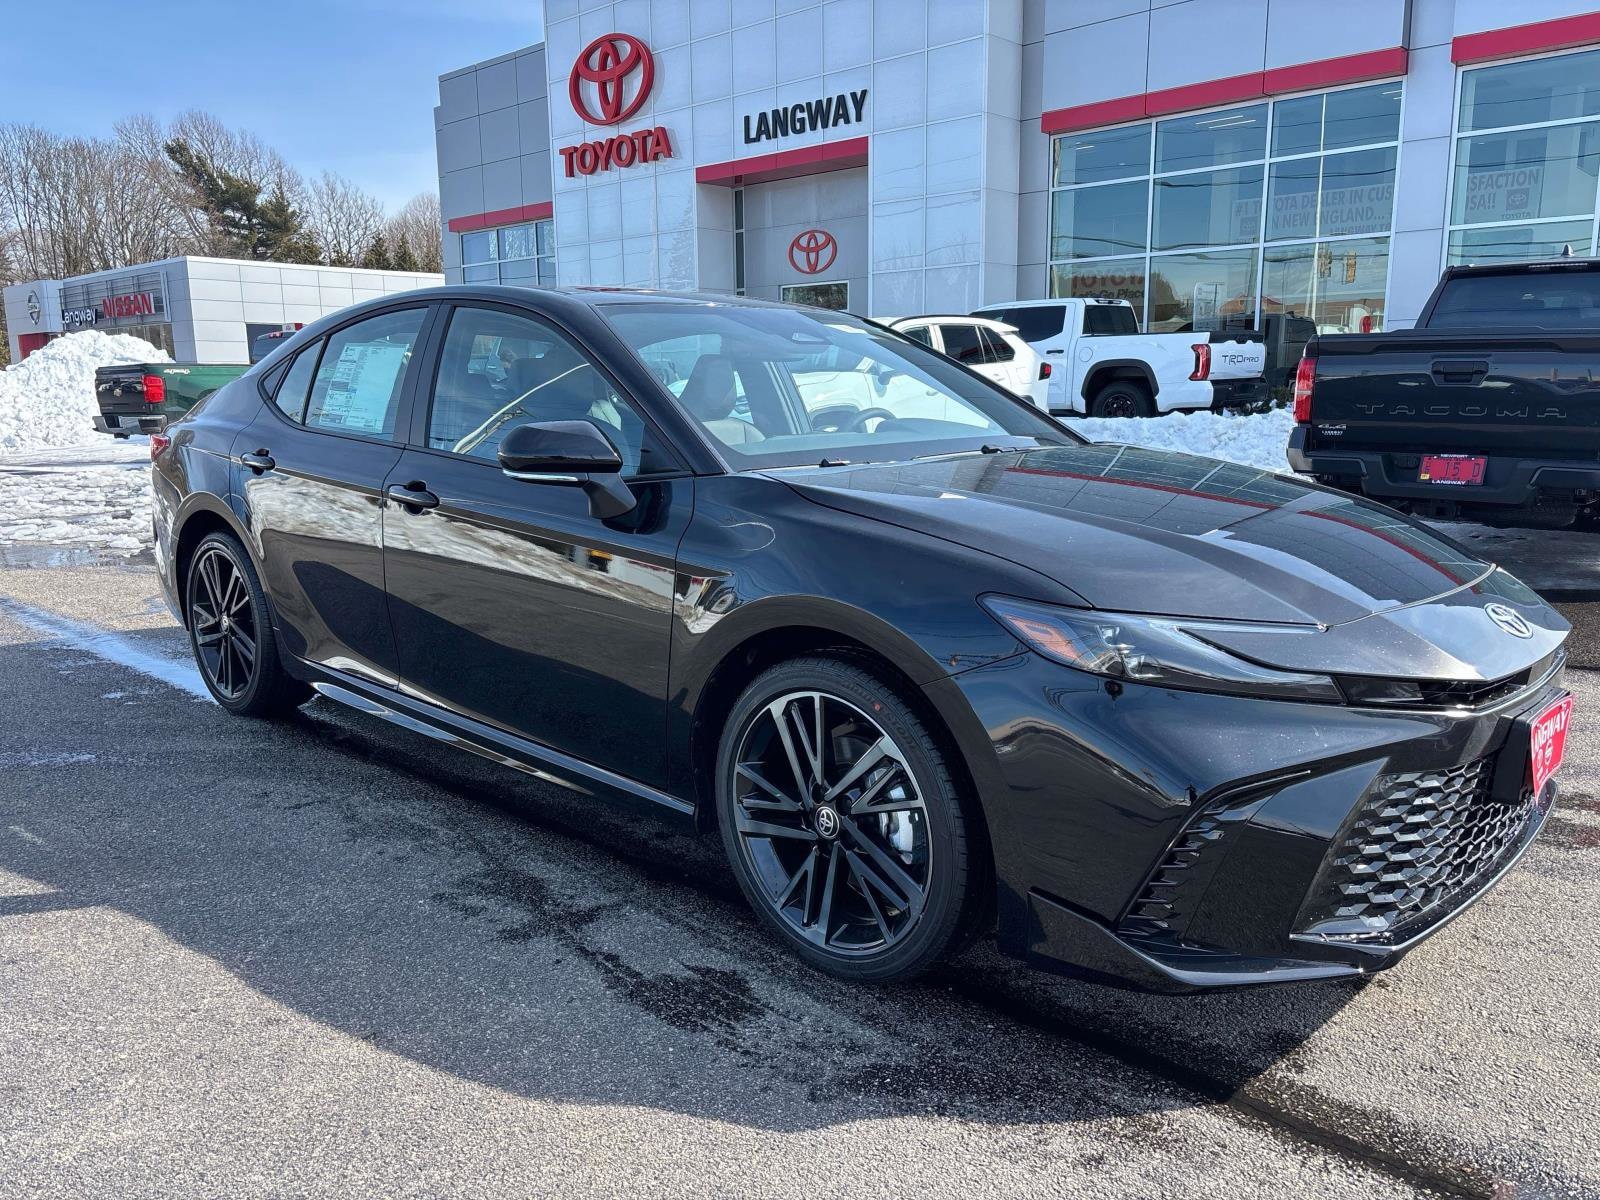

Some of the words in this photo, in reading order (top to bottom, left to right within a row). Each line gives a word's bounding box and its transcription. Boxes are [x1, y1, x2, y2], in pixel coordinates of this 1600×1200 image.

[744, 89, 868, 144] LANGWAY
[559, 126, 674, 177] TOYOTA
[1350, 185, 1364, 202] IN
[1283, 212, 1311, 229] NEW
[61, 308, 97, 326] Langway
[102, 292, 155, 319] NISSAN
[1222, 354, 1244, 365] TRD
[1354, 403, 1568, 419] TACOMA
